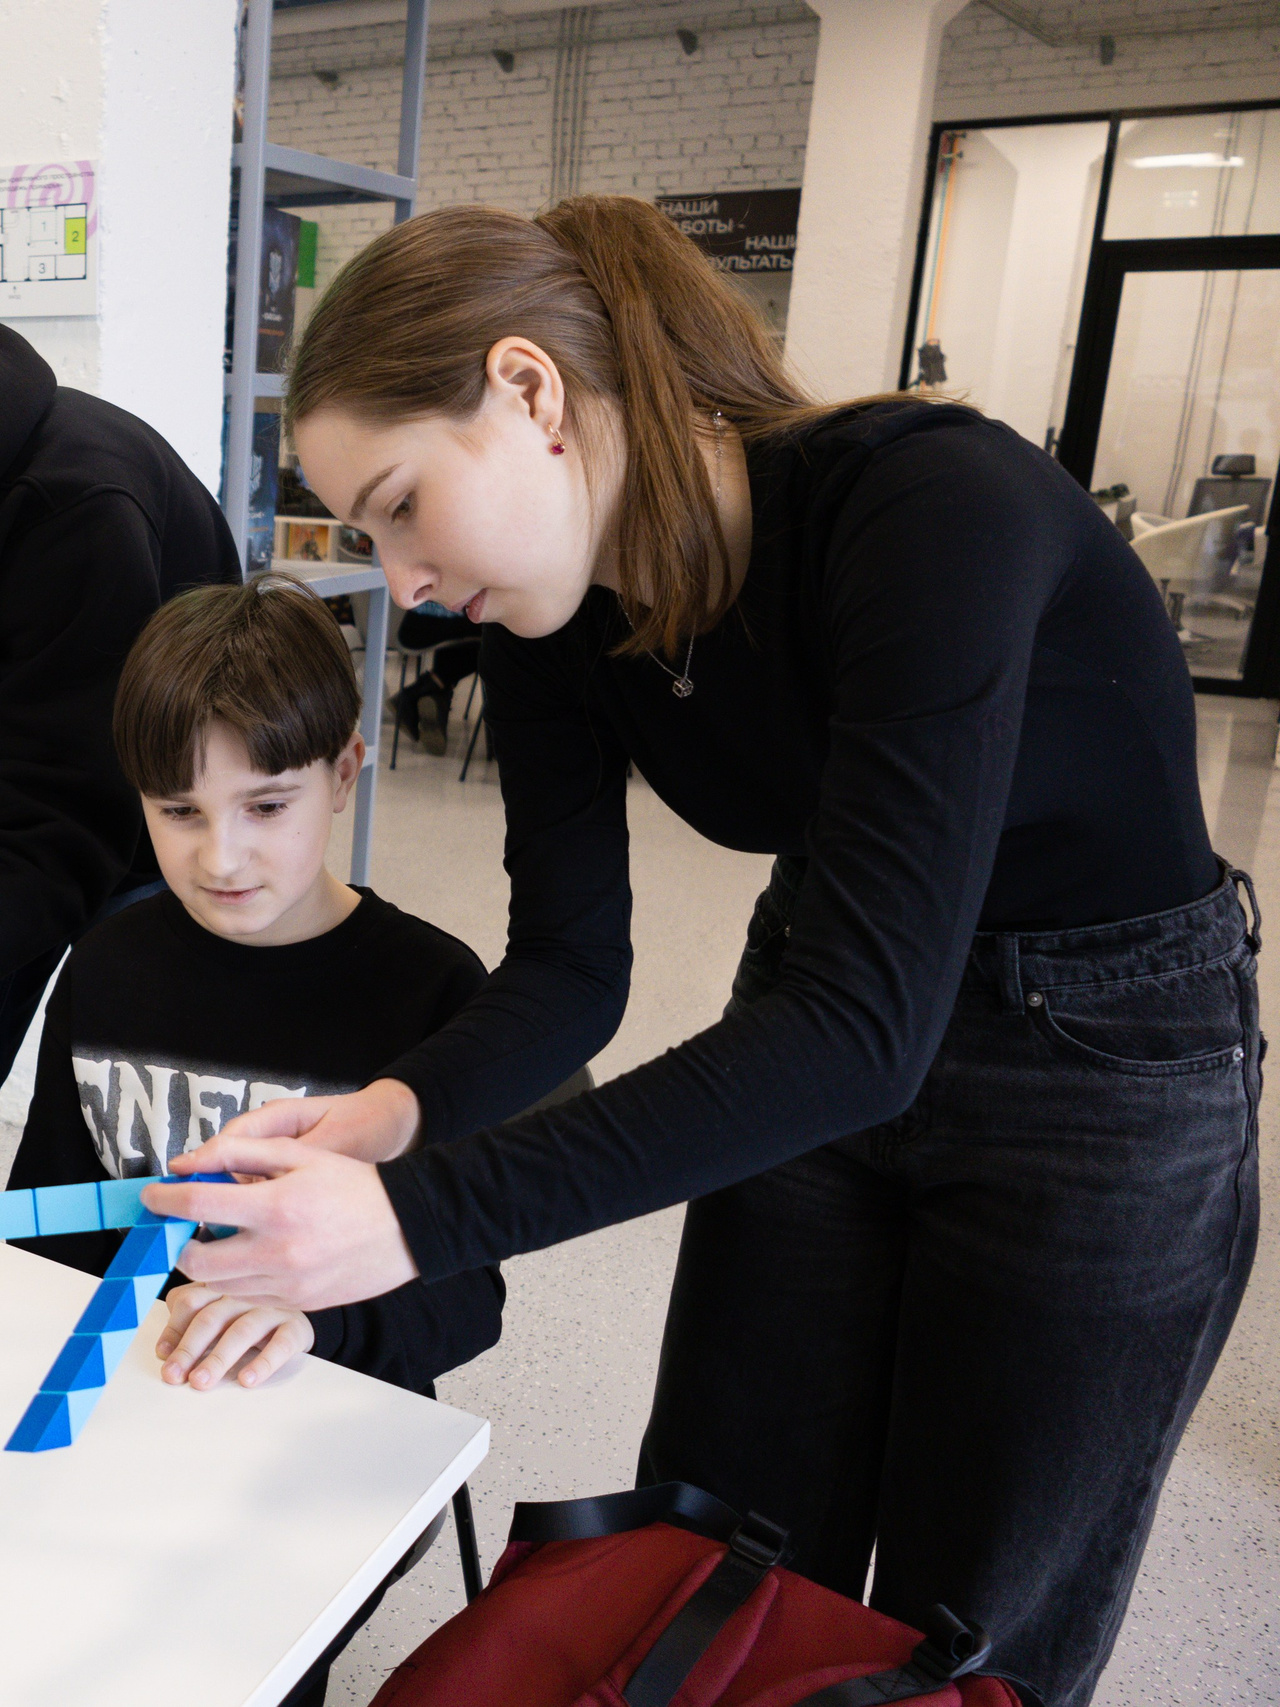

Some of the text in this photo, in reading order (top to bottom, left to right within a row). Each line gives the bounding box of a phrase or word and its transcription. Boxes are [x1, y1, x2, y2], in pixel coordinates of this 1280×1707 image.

[673, 218, 734, 235] АБОТЫ
[71, 231, 79, 242] 2
[38, 263, 46, 274] 3
